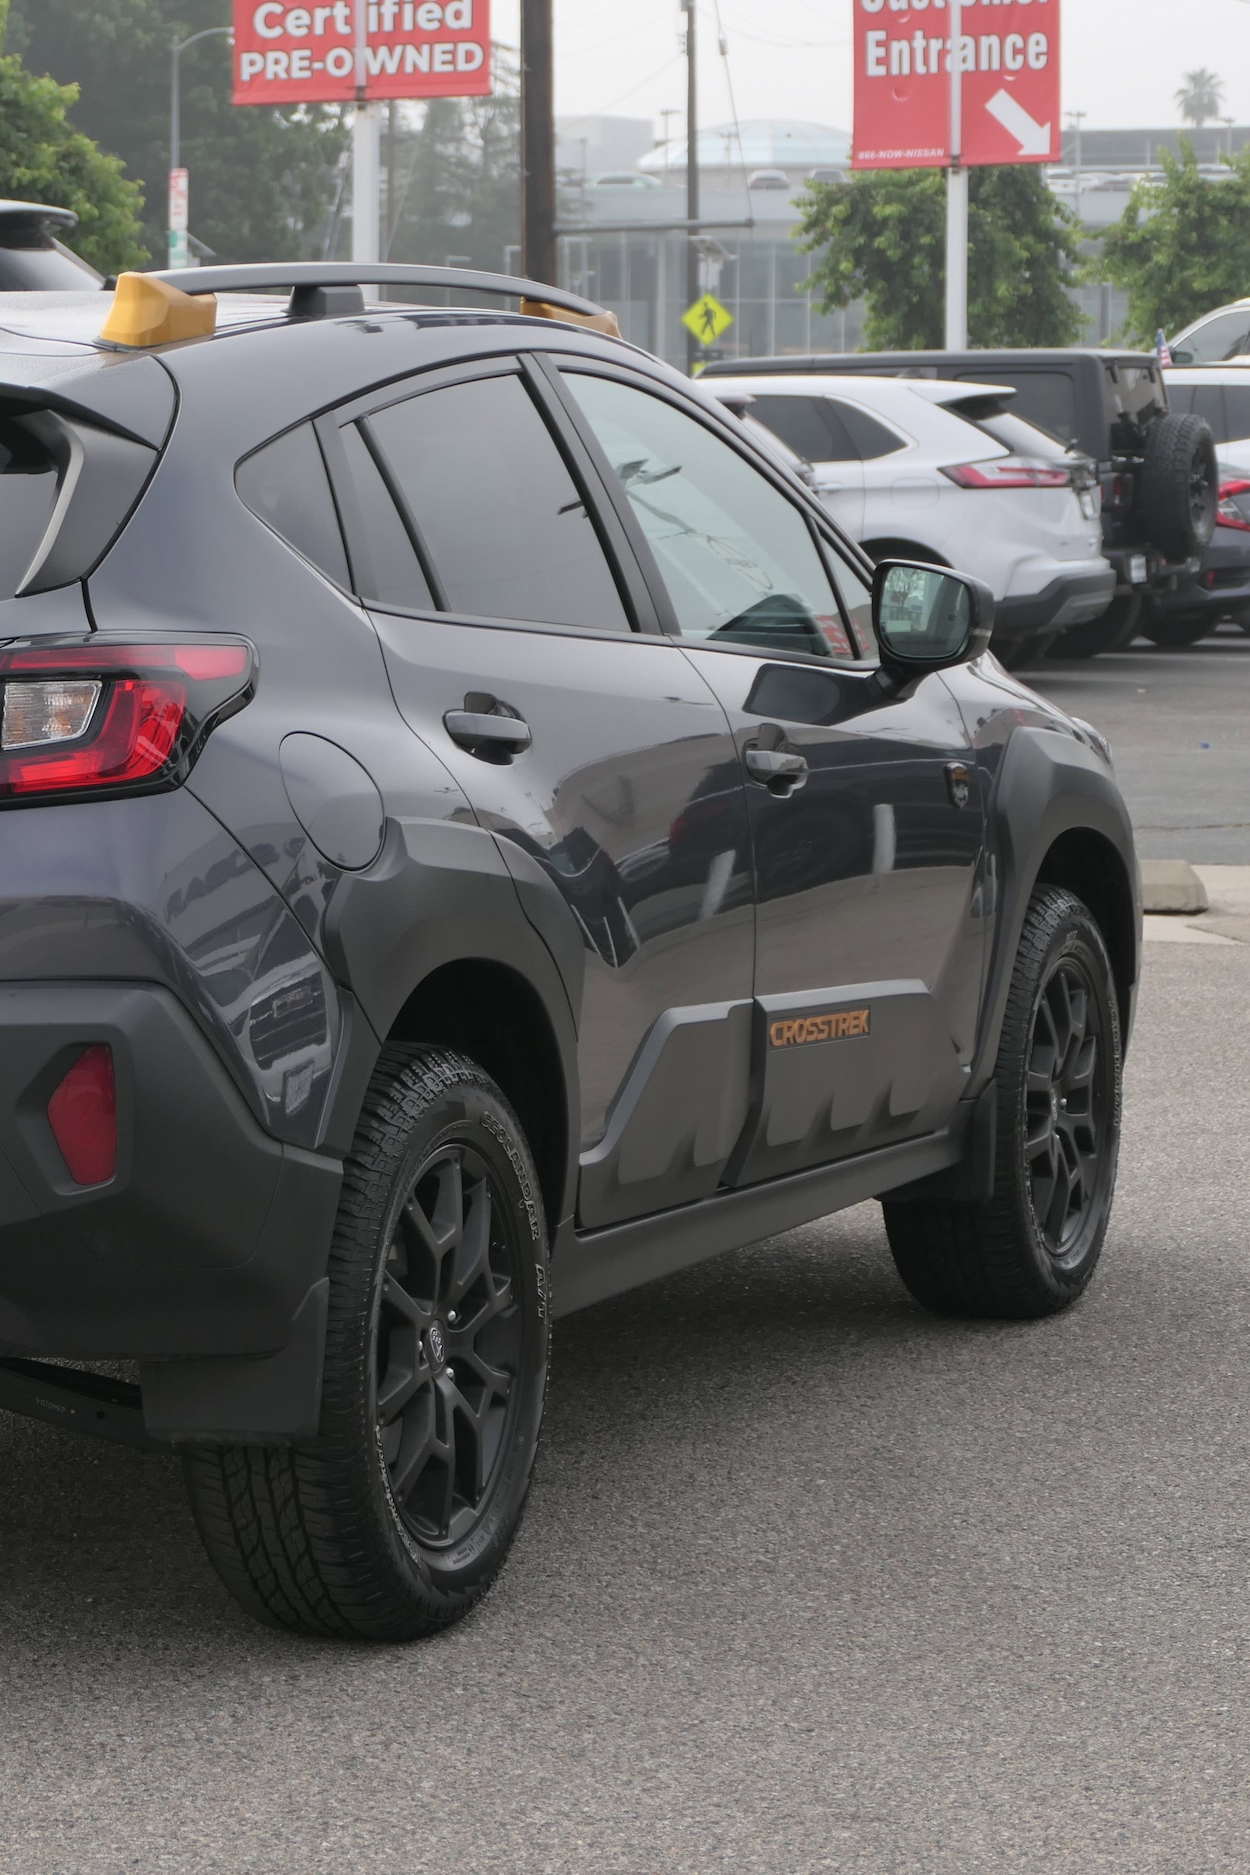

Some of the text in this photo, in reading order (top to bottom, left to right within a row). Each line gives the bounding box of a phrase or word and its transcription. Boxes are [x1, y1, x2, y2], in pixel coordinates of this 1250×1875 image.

[252, 0, 473, 39] Certified
[240, 41, 485, 82] PRE-OWNED
[865, 29, 1049, 77] Entrance
[770, 1009, 870, 1047] CROSSTREK
[480, 1111, 541, 1241] GEOLANDAR
